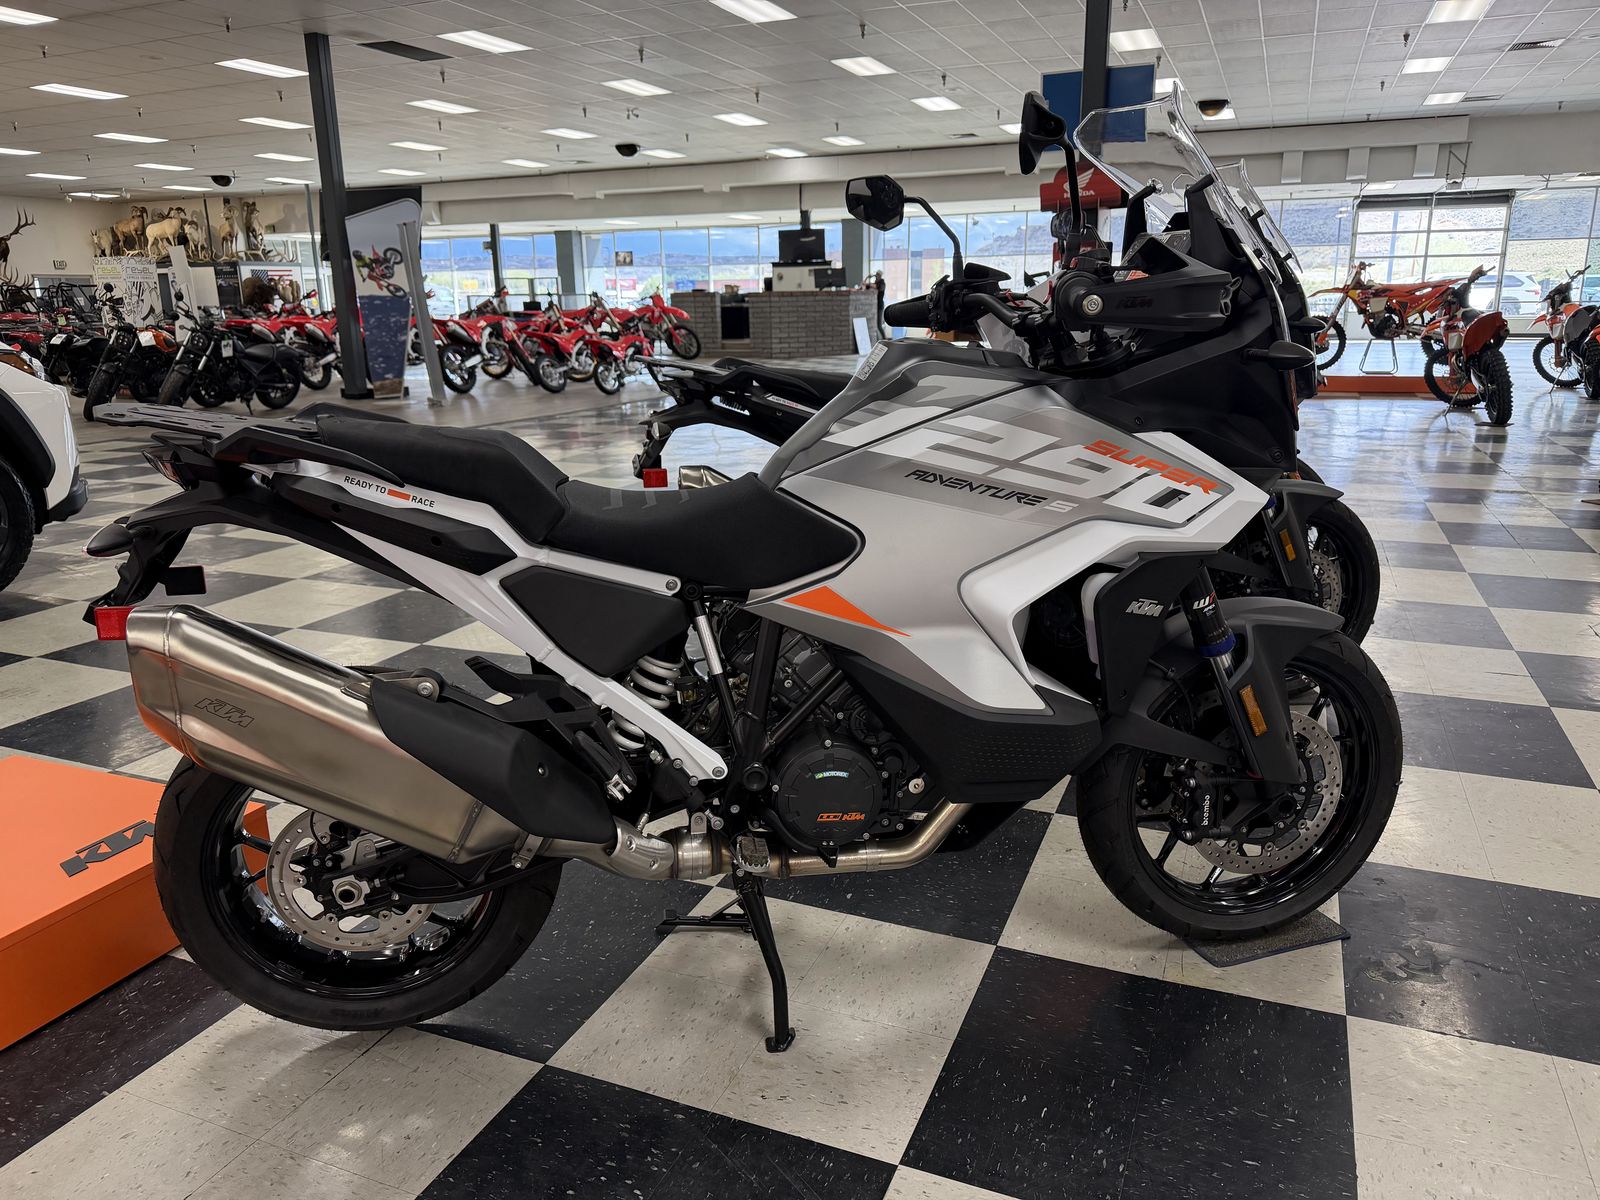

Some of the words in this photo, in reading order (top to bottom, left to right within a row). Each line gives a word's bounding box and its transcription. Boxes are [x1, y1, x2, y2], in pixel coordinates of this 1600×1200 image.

[1063, 190, 1096, 199] HNDA
[1083, 439, 1218, 495] SUPER
[343, 475, 373, 490] READY
[375, 484, 387, 495] TO
[411, 495, 436, 508] RACE
[903, 468, 1049, 507] ADVENTURE
[1125, 598, 1165, 617] KTM
[194, 697, 255, 728] KTM
[1201, 794, 1211, 826] brembo
